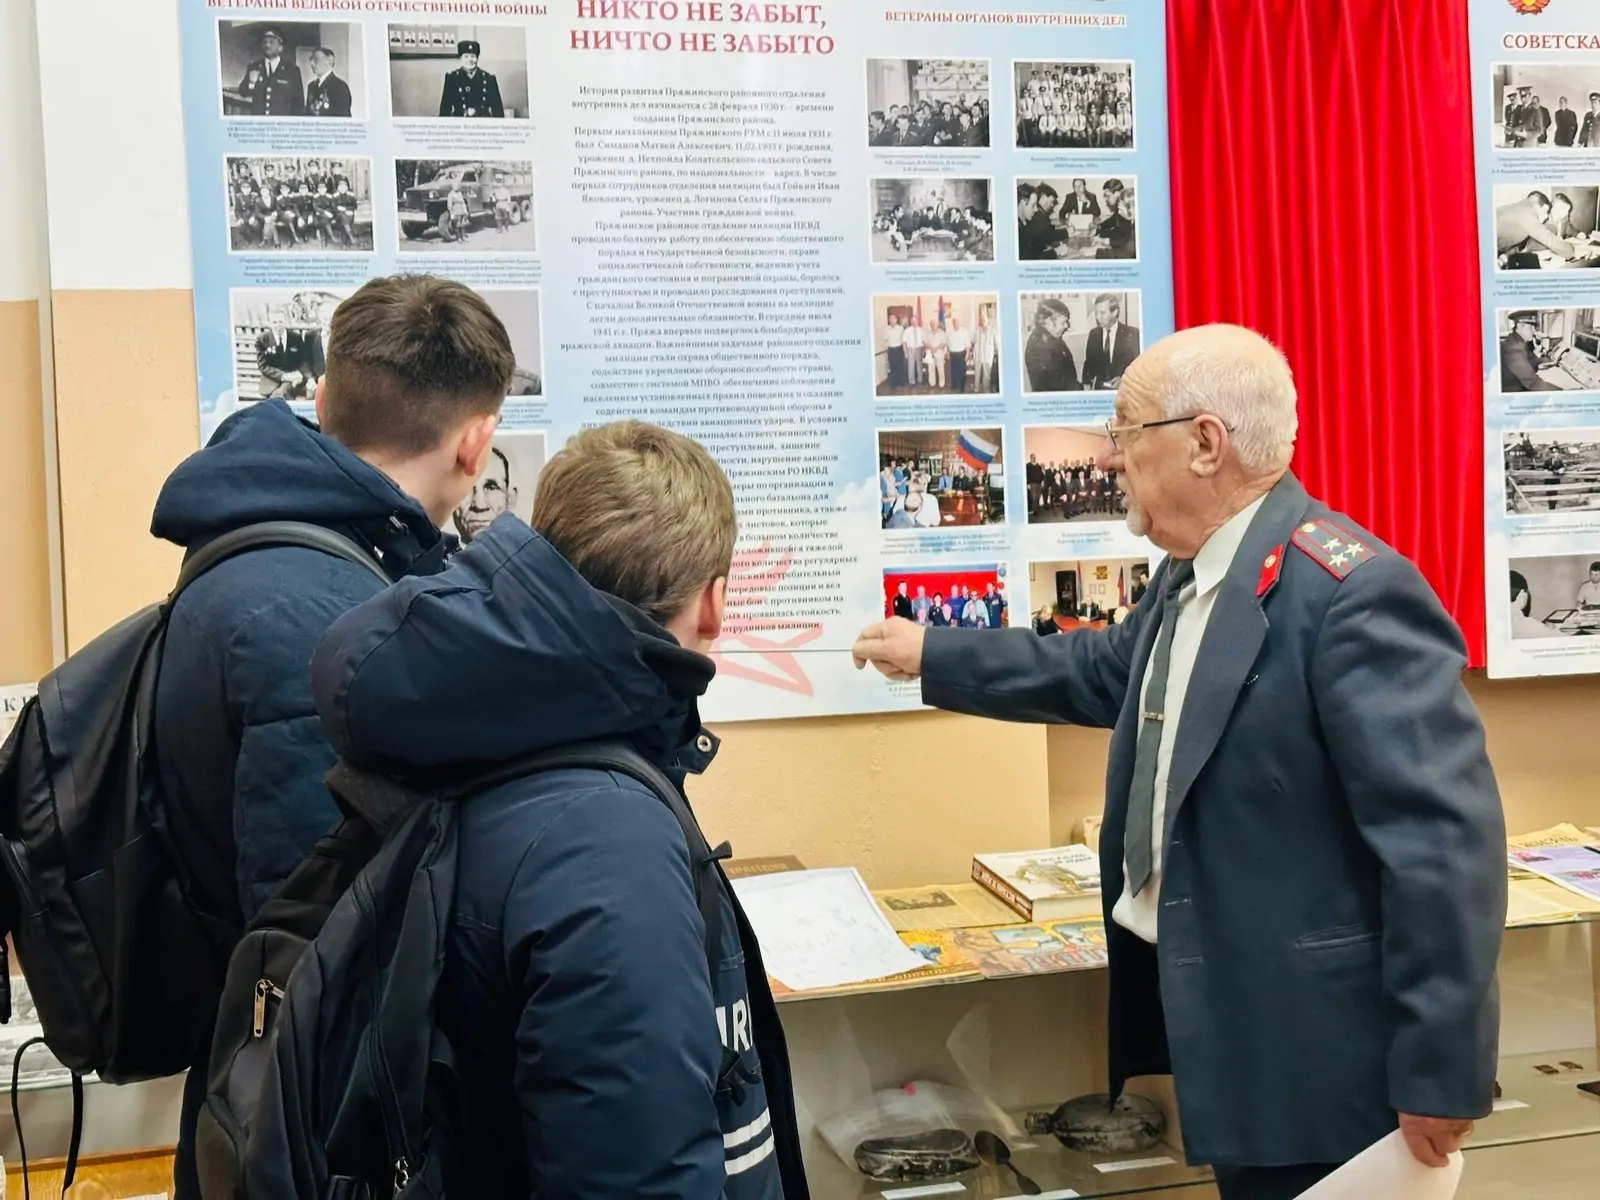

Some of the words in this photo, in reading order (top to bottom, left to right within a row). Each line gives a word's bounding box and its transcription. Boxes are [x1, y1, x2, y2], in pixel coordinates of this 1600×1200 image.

[207, 0, 288, 8] ВЕТЕРАНЫ
[292, 0, 362, 10] ВЕЛИКОЙ
[365, 1, 492, 14] ОТЕЧЕСТВЕННОЙ
[495, 4, 548, 15] ВОЙНЫ
[577, 0, 679, 20] НИКТО
[686, 2, 723, 22] НЕ
[730, 3, 826, 29] ЗАБЫТ,
[885, 11, 953, 23] ВЕТЕРАНЫ
[955, 13, 1014, 24] ОРГАНОВ
[1016, 14, 1099, 26] ВНУТРЕННИХ
[1101, 16, 1126, 27] ДЕЛ
[569, 30, 672, 51] НИЧТО
[679, 32, 717, 52] НЕ
[723, 33, 835, 55] ЗАБЫТО
[724, 466, 785, 479] Пряжинским
[787, 465, 799, 475] РО
[801, 464, 827, 475] НКВД
[768, 480, 826, 491] организации
[766, 491, 811, 502] батальона
[812, 492, 828, 502] для
[820, 505, 846, 513] также
[790, 518, 827, 529] которые
[745, 530, 786, 542] большом
[788, 530, 838, 540] количестве
[741, 543, 803, 555] сложившейся
[805, 541, 842, 552] тяжелой
[751, 557, 802, 567] количества
[804, 555, 857, 567] регулярных
[731, 570, 764, 581] инский
[766, 566, 840, 581] истребительный
[728, 584, 775, 595] передовые
[778, 582, 816, 593] позиции
[825, 581, 840, 590] вел
[746, 596, 762, 606] бои
[770, 595, 831, 606] противником
[742, 609, 793, 621] проявилась
[723, 623, 776, 635] отрудников
